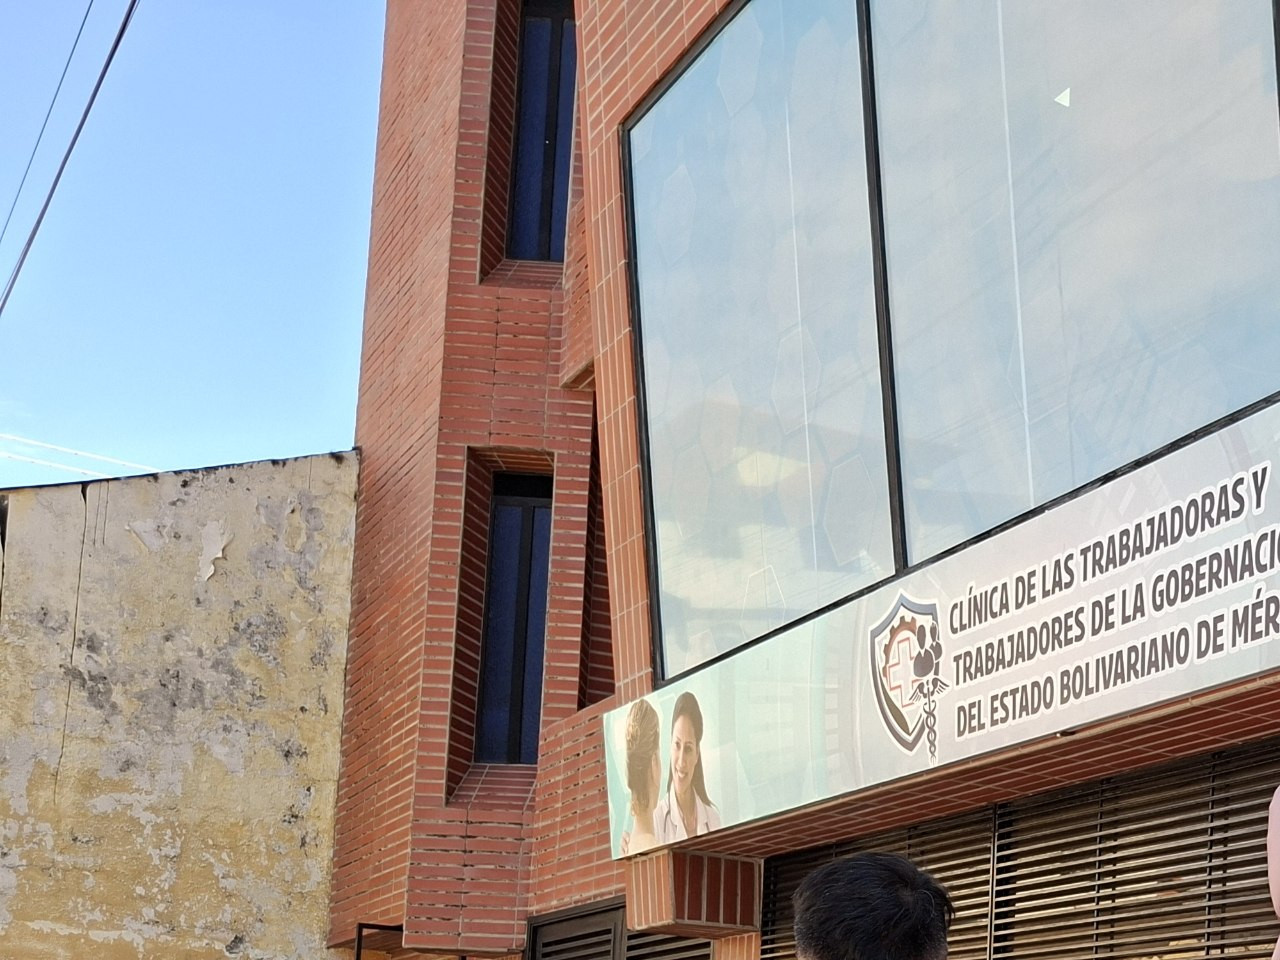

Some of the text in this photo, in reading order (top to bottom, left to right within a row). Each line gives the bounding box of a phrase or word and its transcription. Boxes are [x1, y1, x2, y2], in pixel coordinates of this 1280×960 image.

[950, 466, 1268, 635] CLÍNICA DE LAS TRABAJADORAS Y
[953, 606, 1085, 686] TRABAJADORES
[1091, 593, 1115, 637] DE
[1121, 582, 1145, 626] LA
[957, 694, 985, 737] DEL
[990, 675, 1054, 724] ESTADO
[1060, 627, 1189, 705] BOLIVARIANO
[1197, 614, 1224, 659] DE
